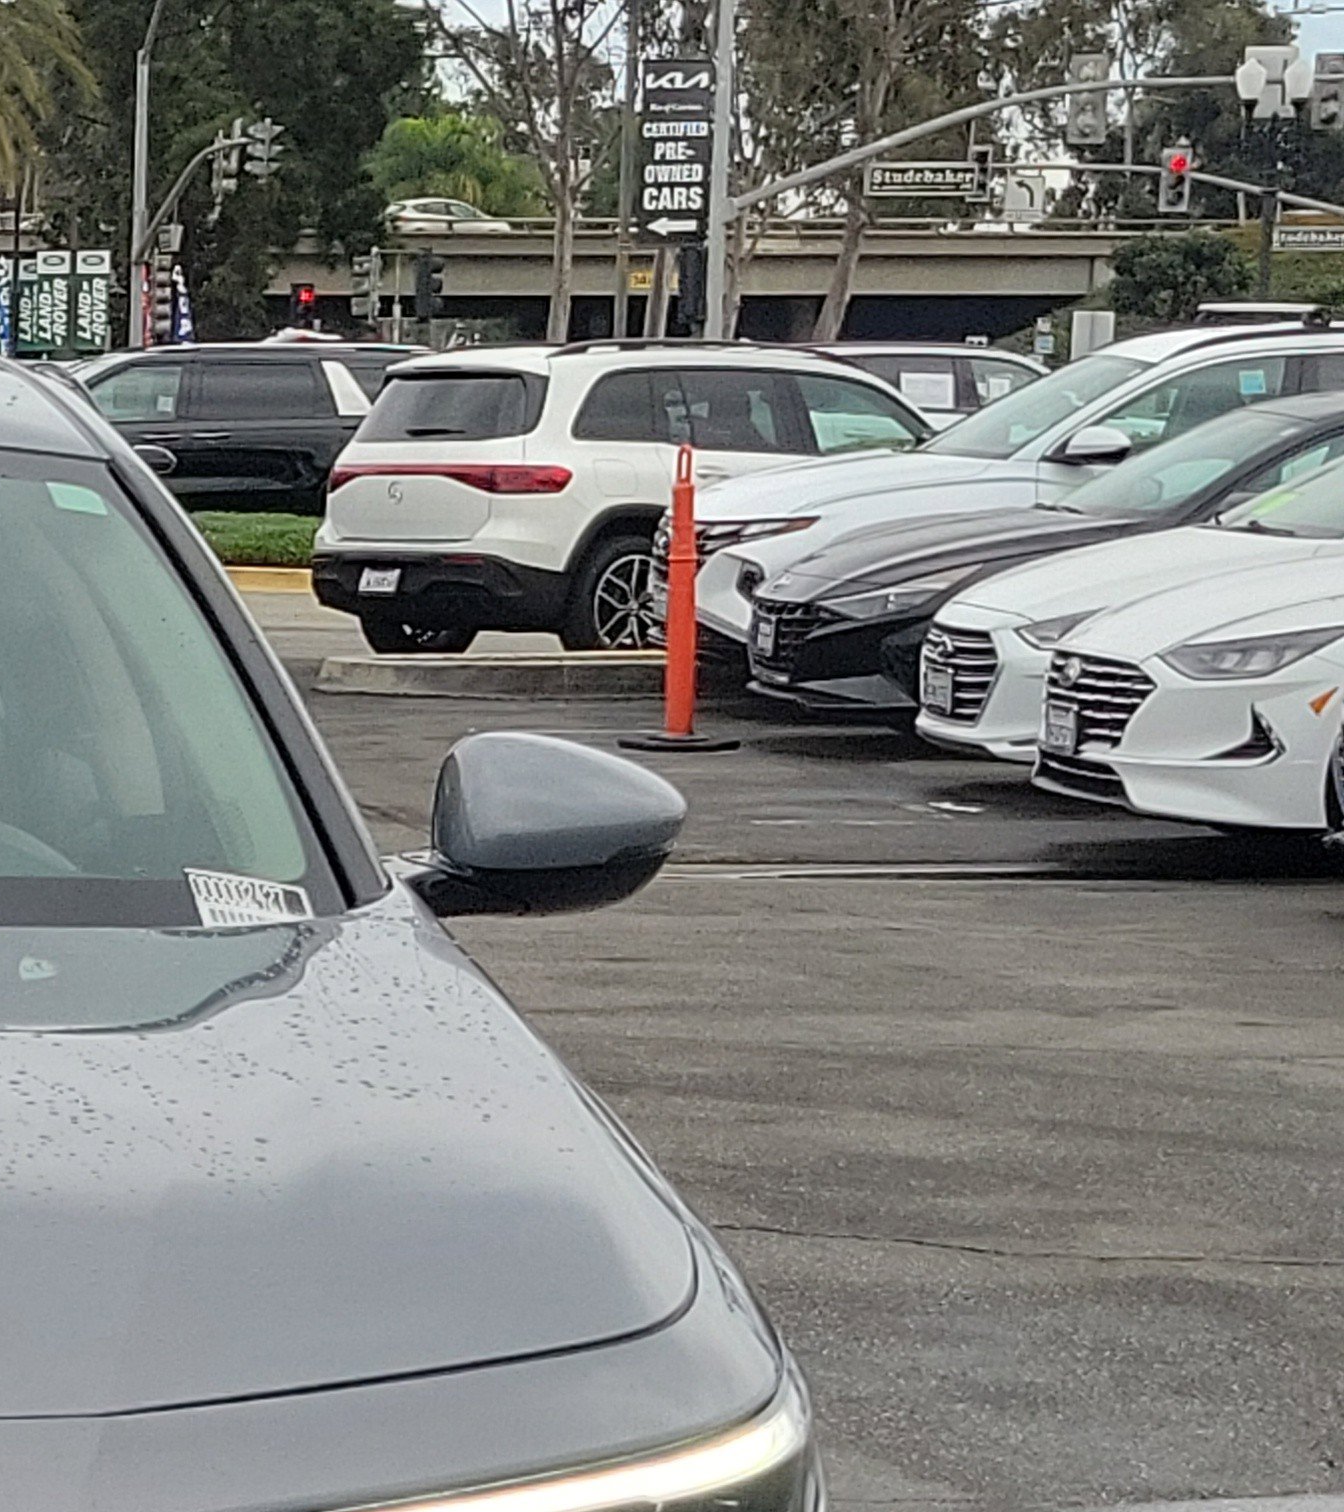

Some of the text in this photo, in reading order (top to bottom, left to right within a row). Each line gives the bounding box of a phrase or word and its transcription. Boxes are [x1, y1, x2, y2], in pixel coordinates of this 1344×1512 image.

[653, 141, 696, 161] PRE-
[643, 163, 704, 183] OWNED
[872, 168, 974, 184] Studebaker
[642, 186, 704, 211] CARS
